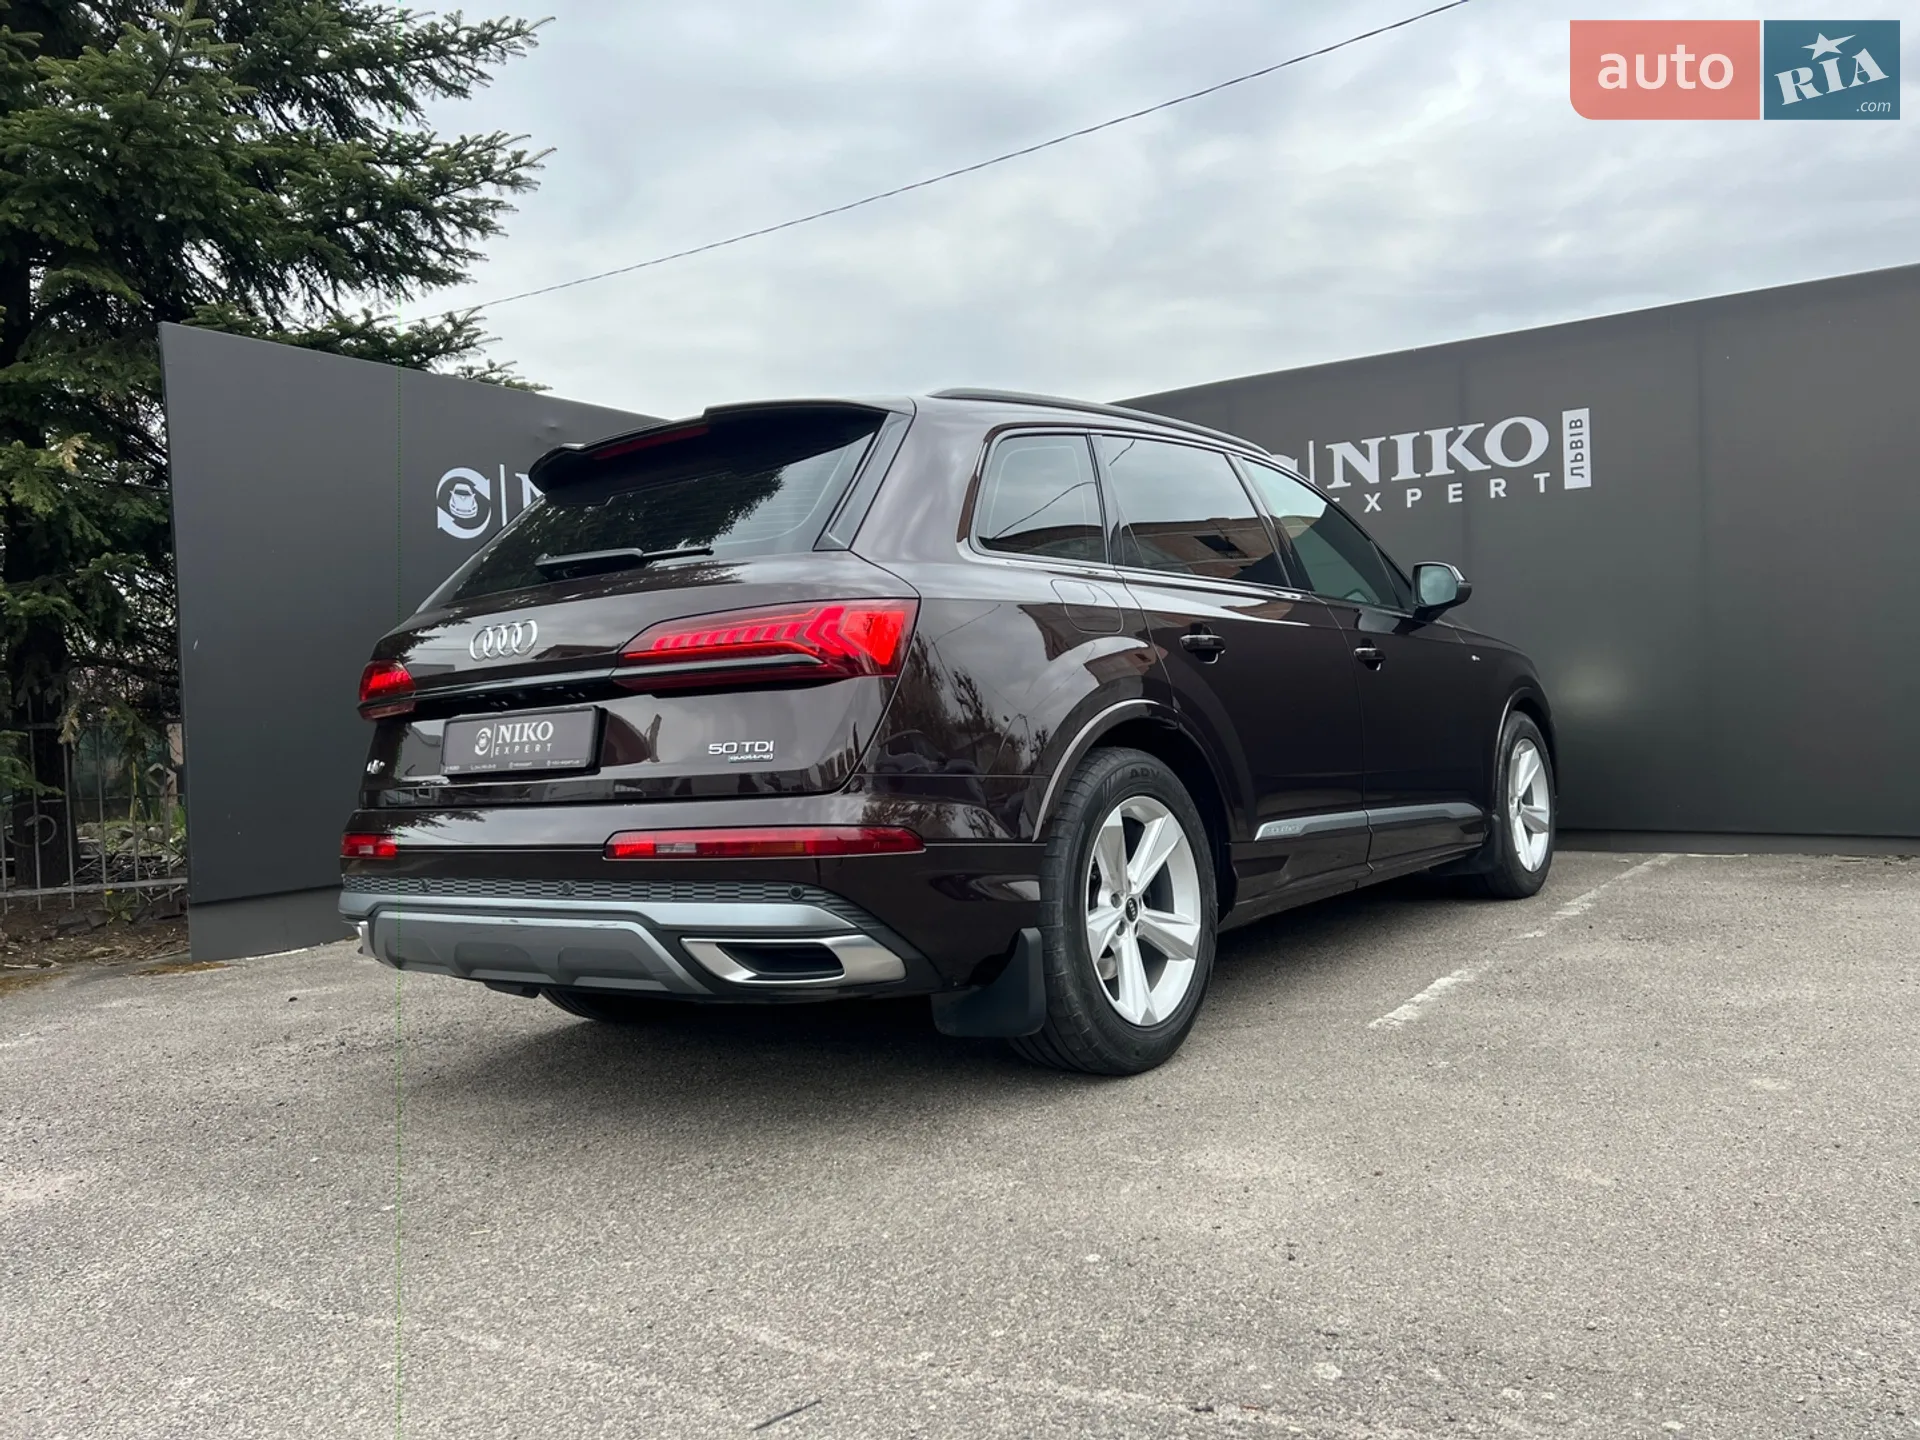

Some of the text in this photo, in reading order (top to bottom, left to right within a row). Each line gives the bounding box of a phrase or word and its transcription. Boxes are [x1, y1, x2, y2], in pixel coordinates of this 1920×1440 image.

[1325, 415, 1550, 490] NIKO
[1569, 418, 1585, 479] ЛЬВІВ
[1331, 472, 1551, 514] XPERT
[496, 721, 554, 744] NIKO
[708, 740, 774, 755] 50 TDI
[494, 743, 552, 756] EXPERT
